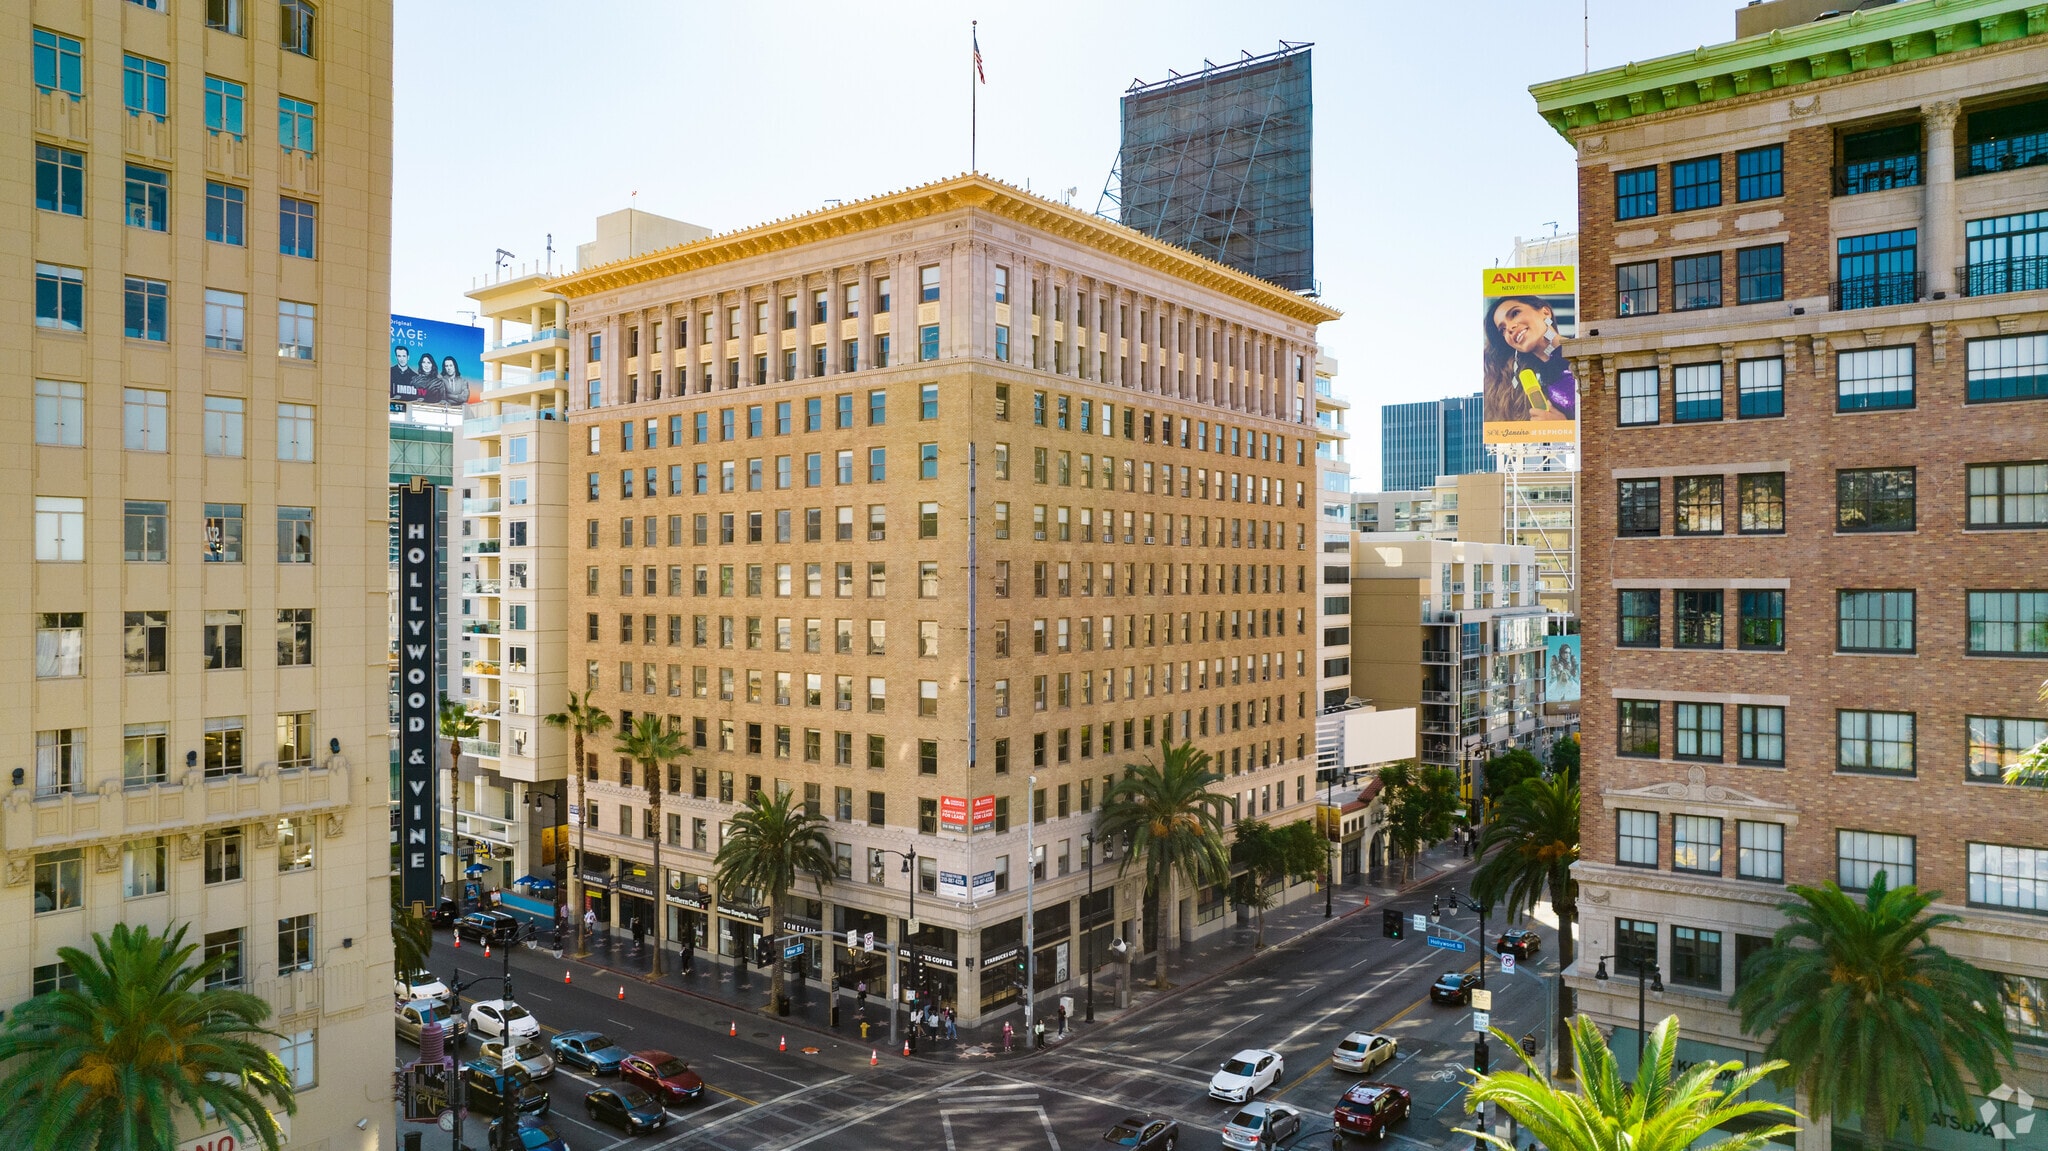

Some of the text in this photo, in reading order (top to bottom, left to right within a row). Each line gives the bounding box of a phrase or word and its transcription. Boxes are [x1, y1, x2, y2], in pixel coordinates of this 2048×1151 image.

[1491, 270, 1567, 284] ANITTA
[396, 384, 417, 395] IMDb
[406, 522, 428, 869] HOLLYWOOD & VINE
[665, 894, 689, 905] Northern
[688, 899, 700, 908] Cafe
[1430, 938, 1456, 949] Hollywood
[932, 956, 953, 967] COFFEE
[984, 951, 1009, 966] STARBUCKS
